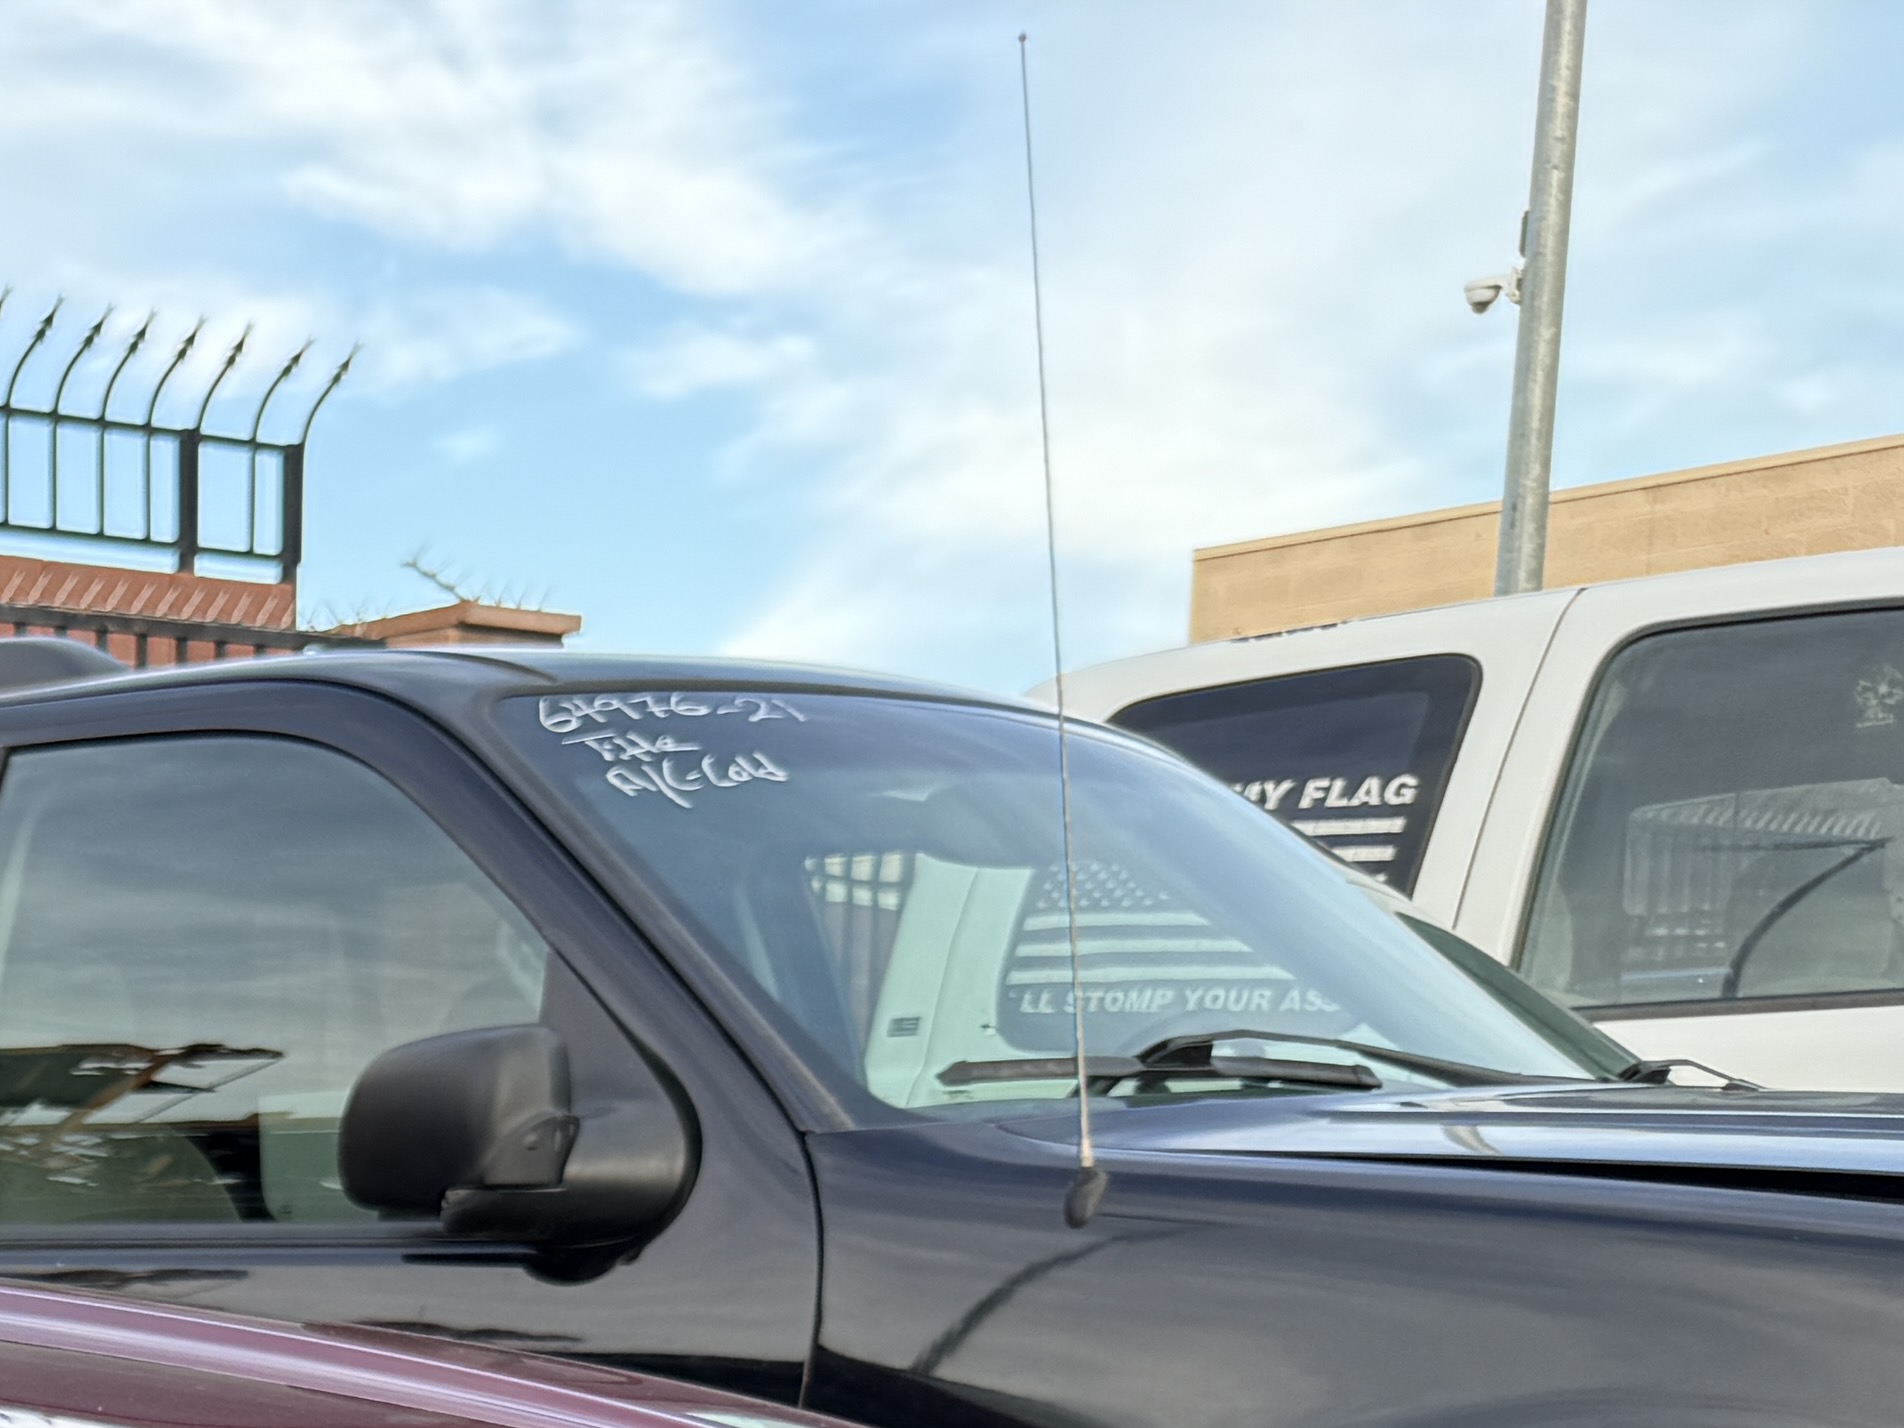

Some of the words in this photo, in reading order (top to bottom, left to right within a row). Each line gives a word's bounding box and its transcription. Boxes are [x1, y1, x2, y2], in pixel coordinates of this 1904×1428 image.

[1298, 773, 1421, 809] FLAG
[1062, 987, 1175, 1014] STOMP
[1184, 986, 1273, 1012] YOUR
